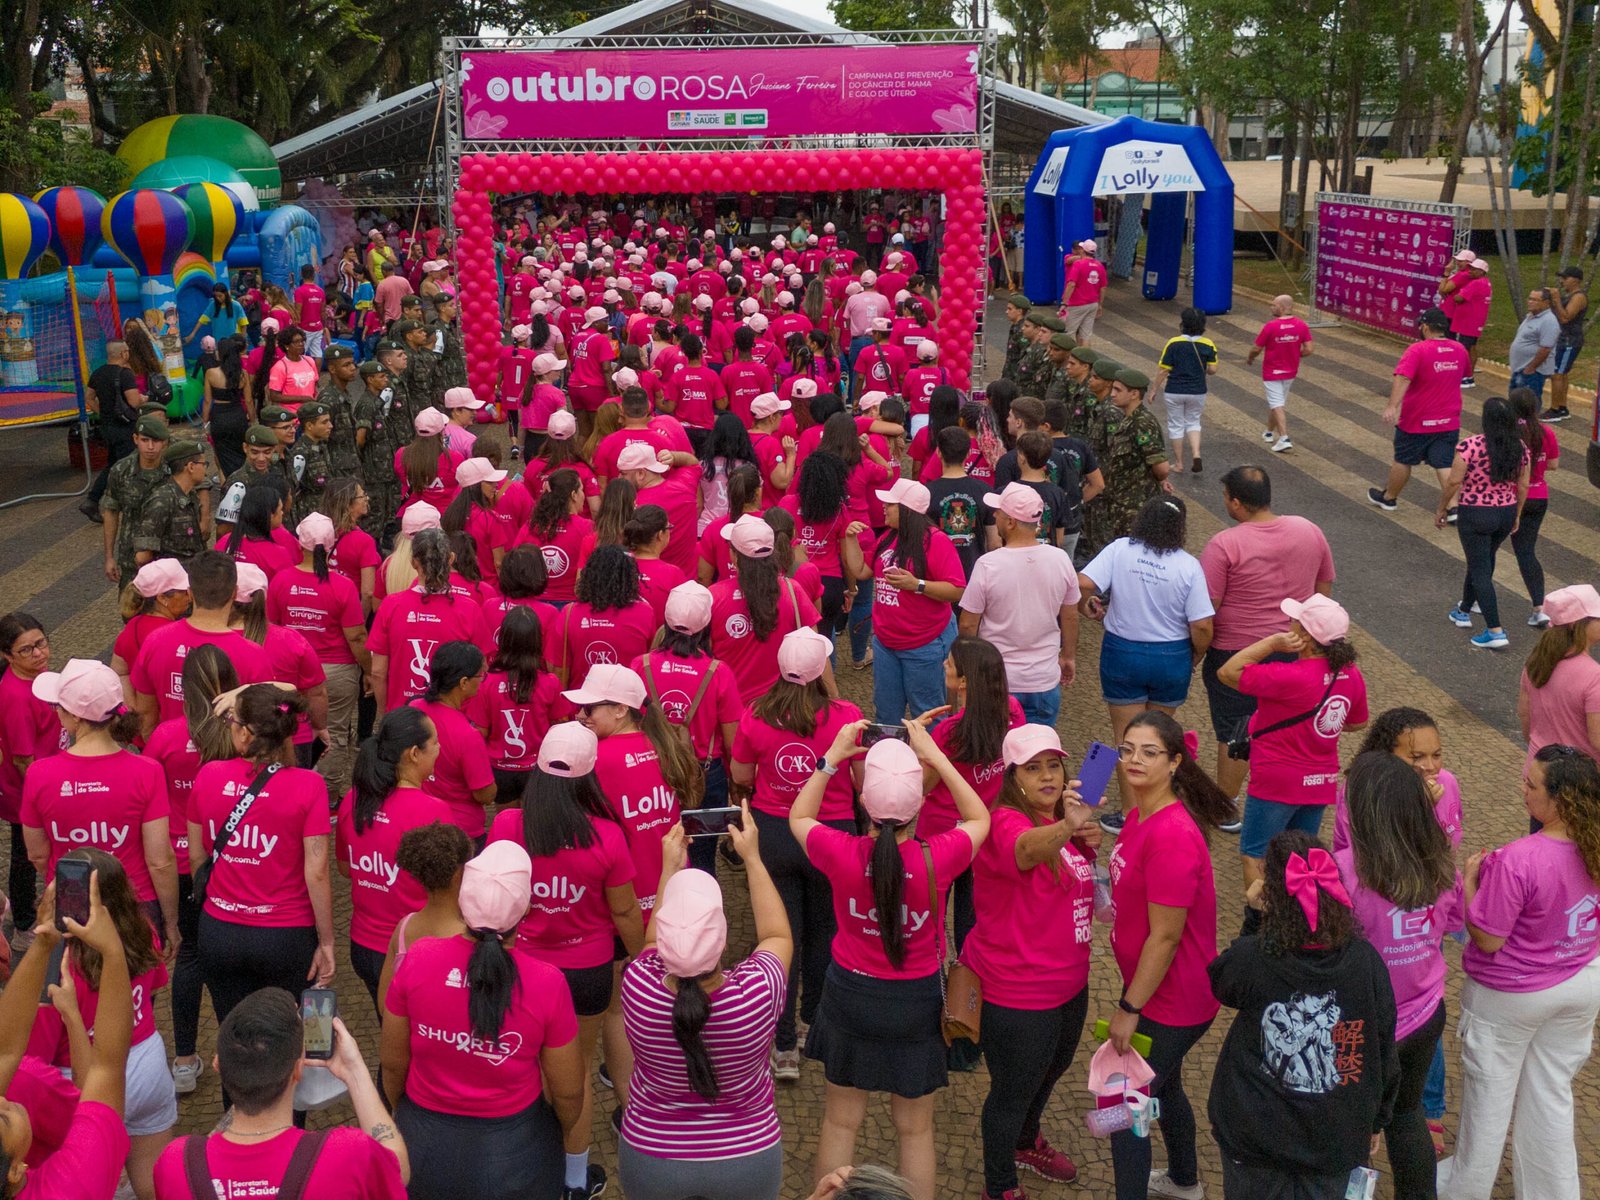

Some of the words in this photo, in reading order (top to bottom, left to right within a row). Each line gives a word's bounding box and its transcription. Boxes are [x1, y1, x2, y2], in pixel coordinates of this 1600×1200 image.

[486, 68, 656, 102] outubro
[661, 75, 748, 101] ROSA
[848, 72, 893, 80] CAMPANHA
[907, 70, 954, 80] PREVENÇÃO
[848, 81, 861, 89] DO
[862, 80, 894, 89] CÂNCER
[895, 80, 906, 88] DE
[907, 80, 932, 88] MAMA
[848, 90, 854, 98] E
[855, 90, 877, 98] COLO
[890, 88, 917, 97] ÚTERO
[1100, 175, 1108, 189] I
[1112, 167, 1160, 191] Lolly
[1162, 173, 1194, 187] you
[88, 785, 110, 793] Saúde
[225, 793, 255, 832] adidas
[622, 785, 676, 819] Lolly
[51, 820, 129, 849] Lolly
[348, 844, 400, 886] Lolly
[532, 875, 587, 904] olly
[232, 1180, 269, 1188] Secretaria
[233, 1188, 247, 1197] de
